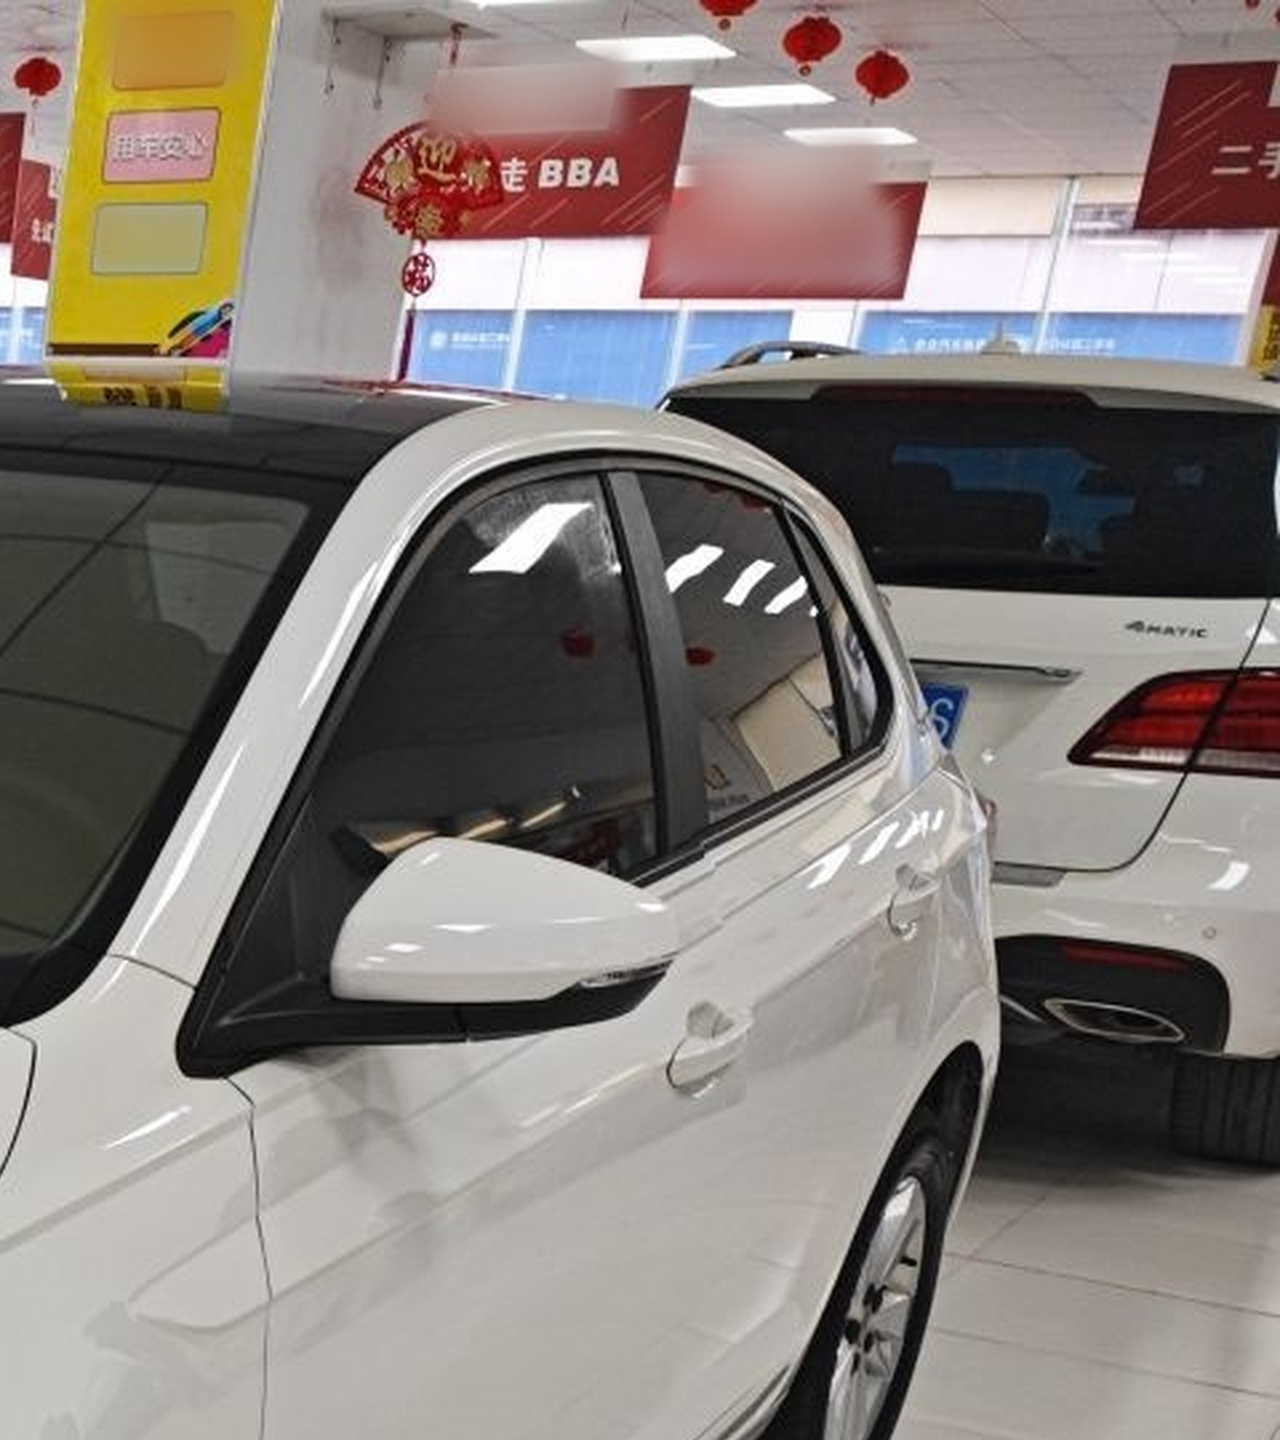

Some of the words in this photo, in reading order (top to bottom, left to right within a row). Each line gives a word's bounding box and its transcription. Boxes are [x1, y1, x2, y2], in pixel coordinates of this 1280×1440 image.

[113, 131, 210, 161] 用车安心
[500, 157, 528, 192] 走
[538, 157, 620, 188] BBA
[1124, 619, 1209, 639] 4MATIC
